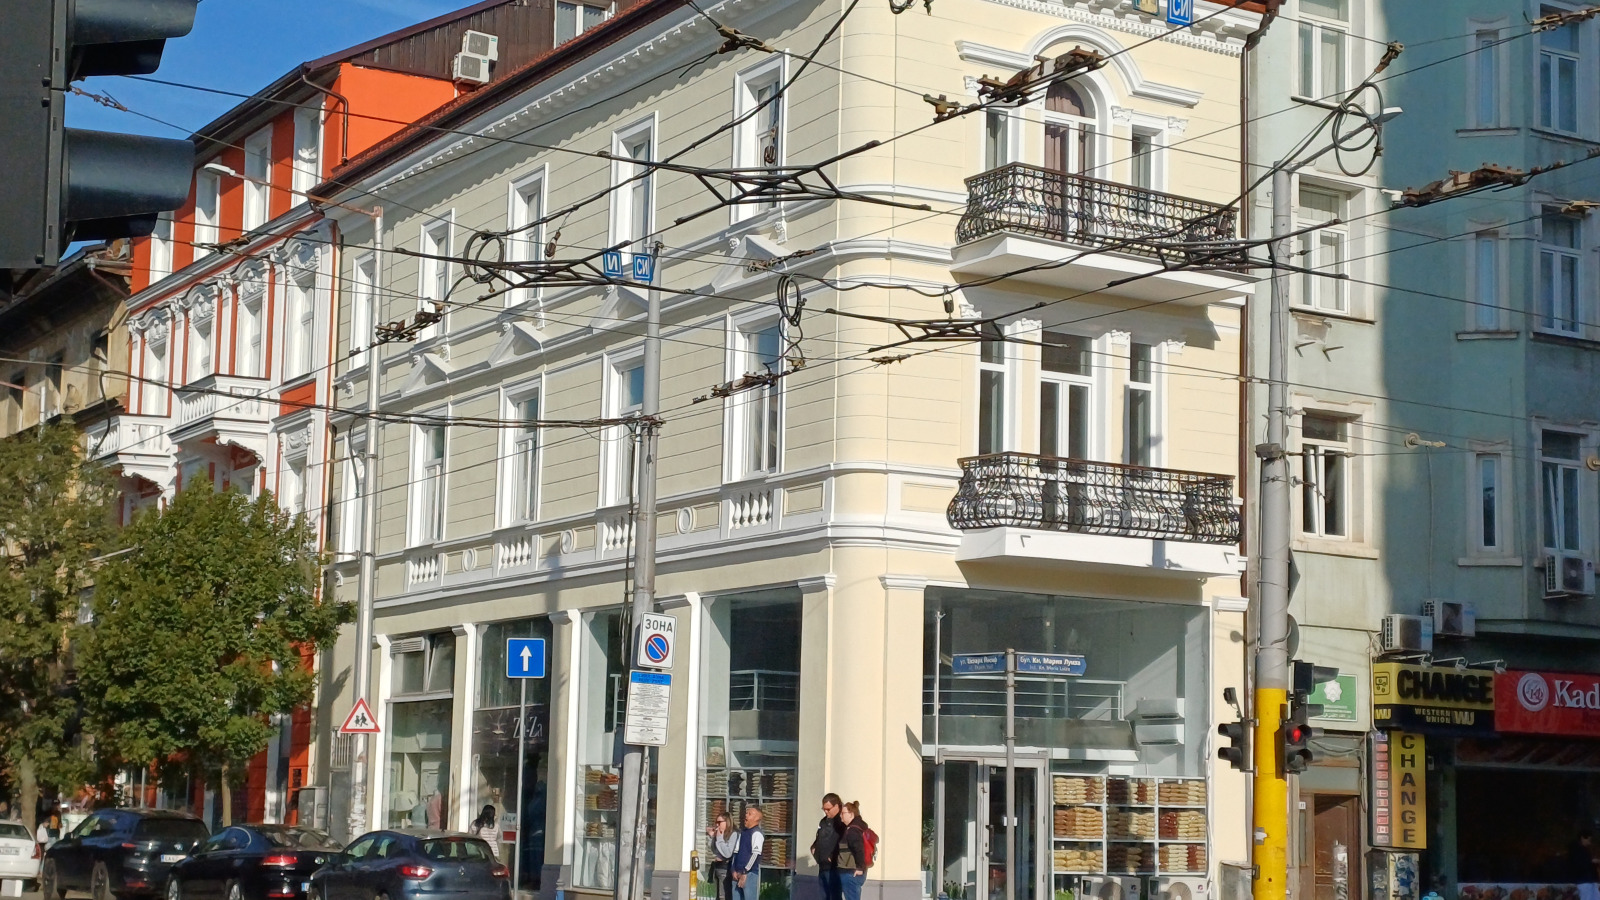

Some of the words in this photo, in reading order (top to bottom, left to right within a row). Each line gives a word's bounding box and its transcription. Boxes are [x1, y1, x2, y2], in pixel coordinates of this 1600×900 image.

[636, 258, 649, 275] СИ
[645, 618, 673, 633] ЗОНА
[1397, 669, 1494, 704] CHANGE
[1553, 680, 1600, 710] Kad
[1414, 708, 1451, 717] WESTERN
[1426, 715, 1451, 724] UNION
[1454, 710, 1475, 726] WU
[513, 716, 543, 739] Z-Za
[1400, 734, 1417, 843] CHANGE
